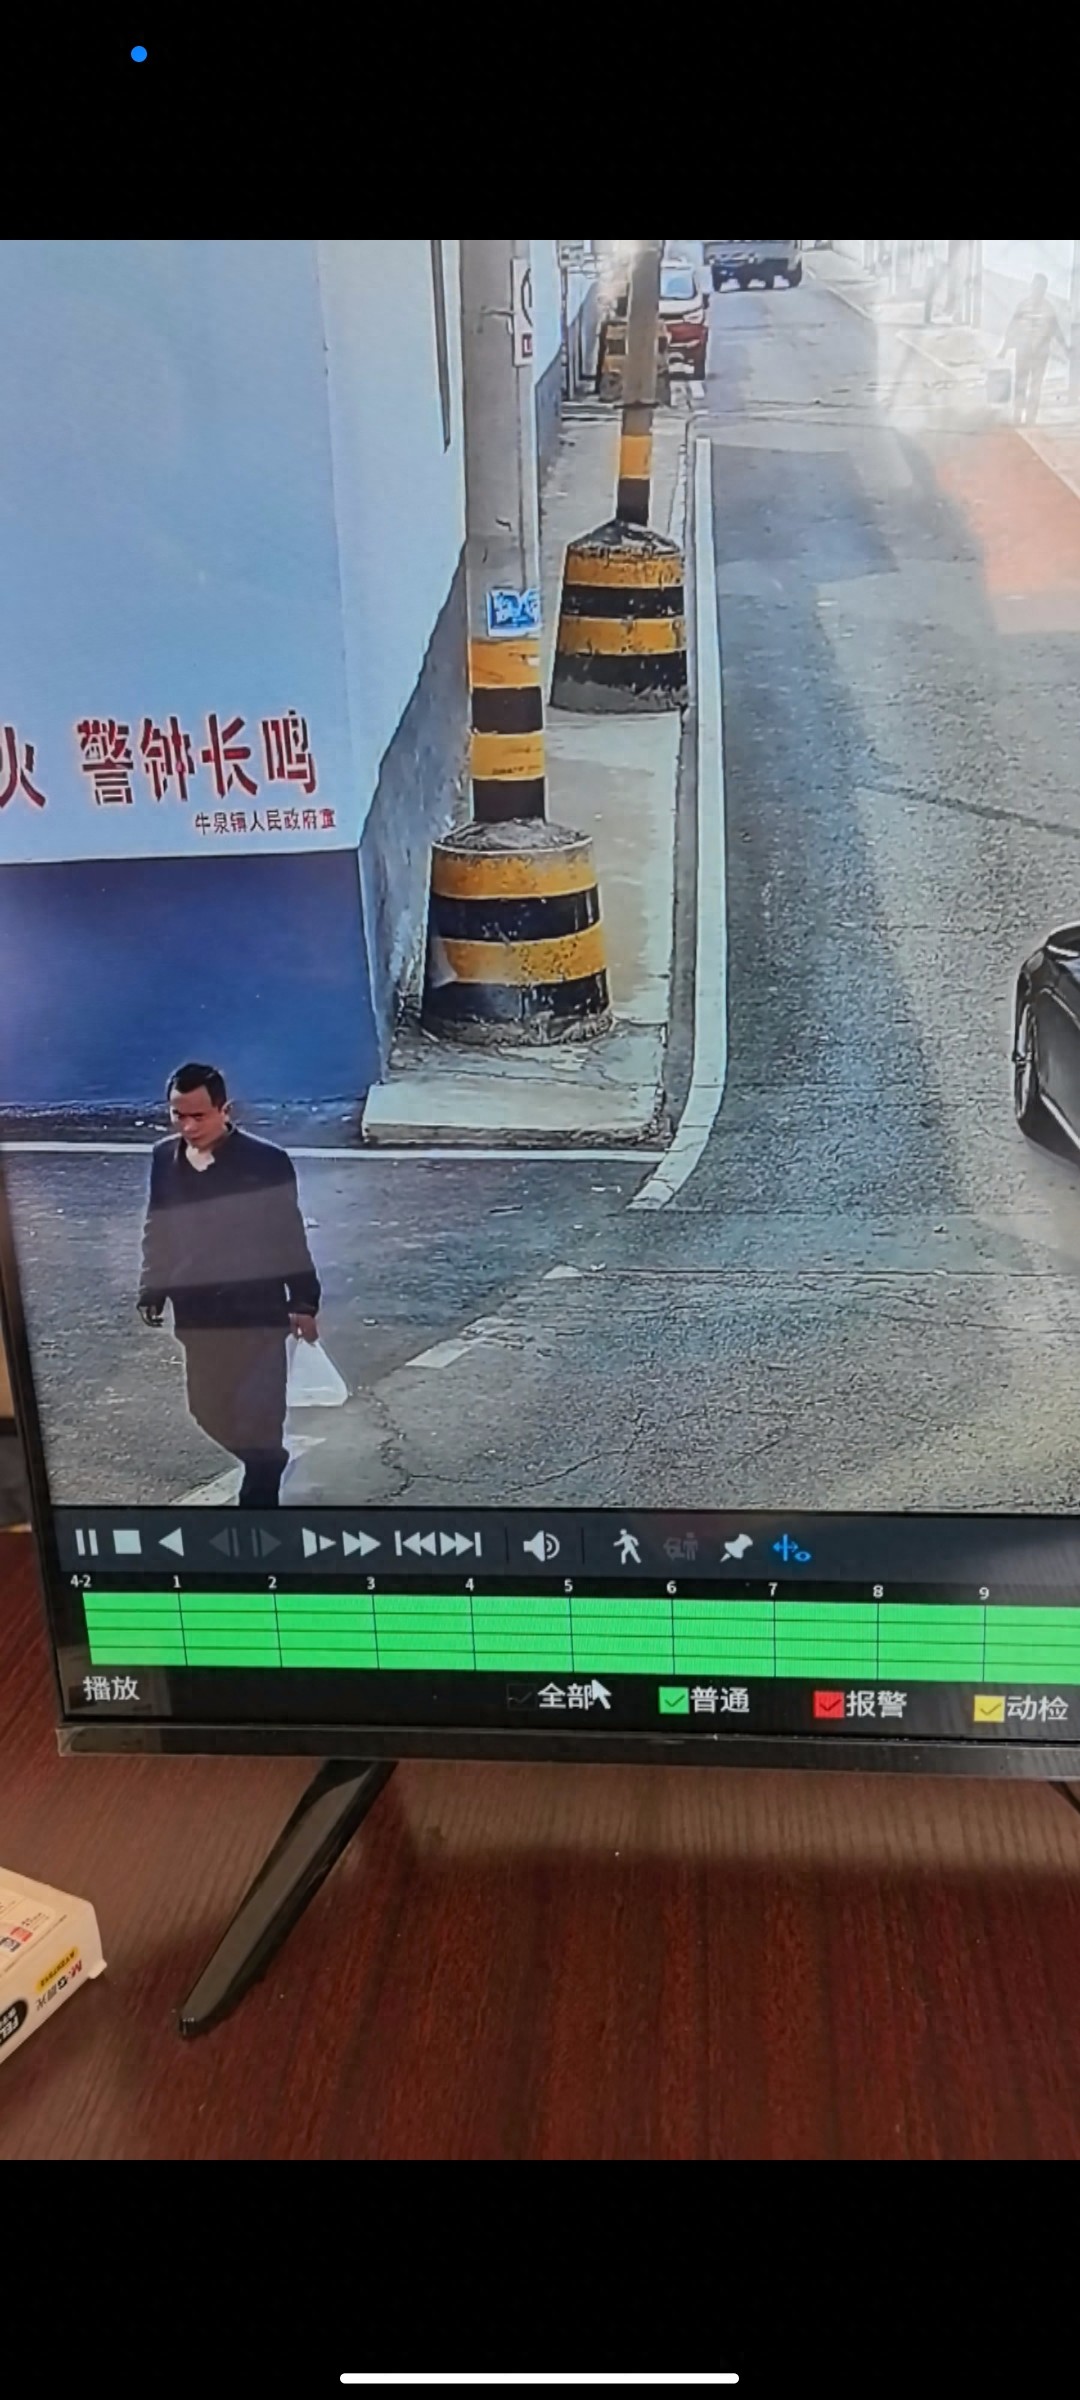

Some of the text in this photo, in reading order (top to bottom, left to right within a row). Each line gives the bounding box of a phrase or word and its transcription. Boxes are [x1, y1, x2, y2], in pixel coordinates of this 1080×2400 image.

[77, 709, 317, 805] 警钟长鸣
[70, 1574, 990, 1601] 4-2 1 2 3 4 5 6 7 8 9
[83, 1675, 140, 1701] 播放
[537, 1682, 593, 1710] 全部
[690, 1686, 750, 1714] 普通
[846, 1690, 907, 1719] 报警
[1007, 1693, 1070, 1723] 动检
